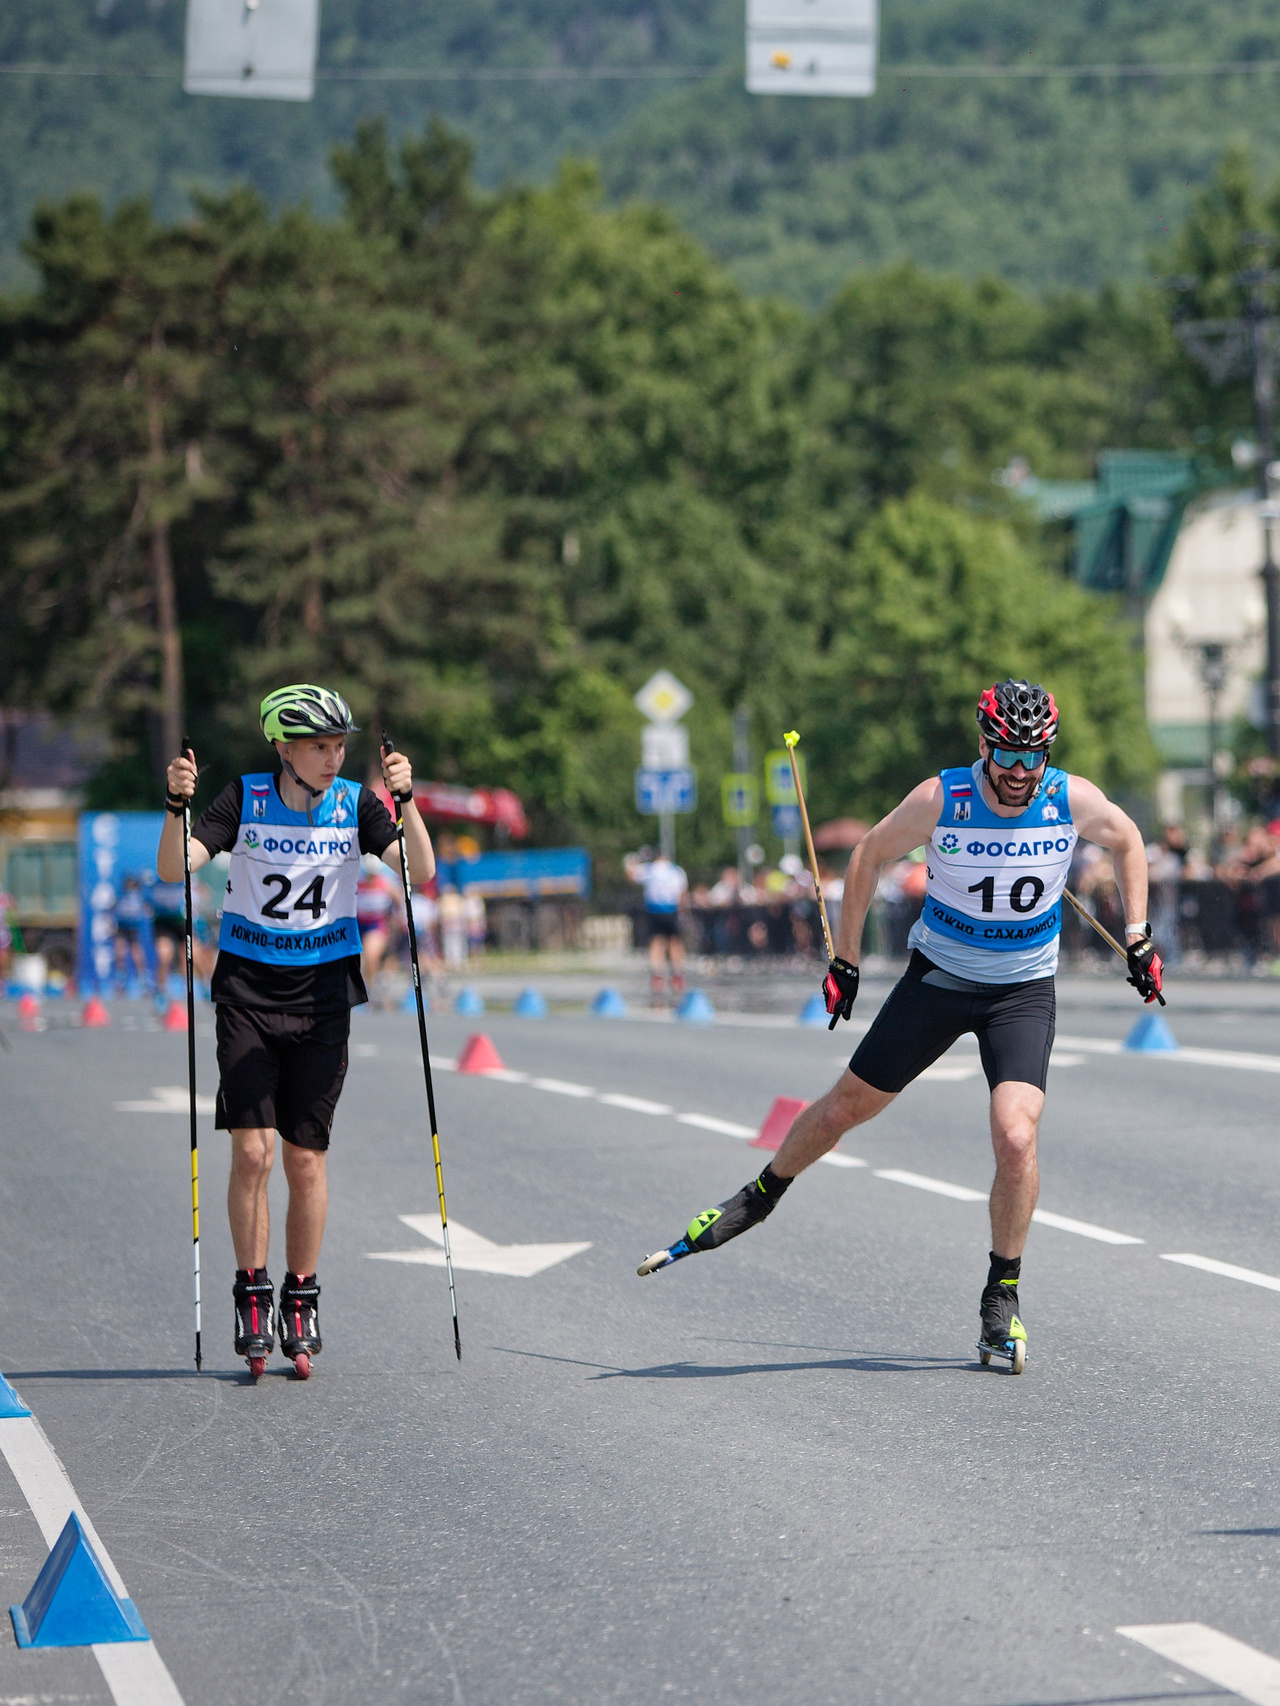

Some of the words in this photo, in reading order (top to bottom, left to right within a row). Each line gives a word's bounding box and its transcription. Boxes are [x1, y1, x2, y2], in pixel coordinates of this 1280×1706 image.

[263, 837, 352, 855] ФОСАГРО
[966, 838, 1070, 857] ФОСАГРО
[261, 874, 326, 919] 24
[968, 876, 1045, 913] 10
